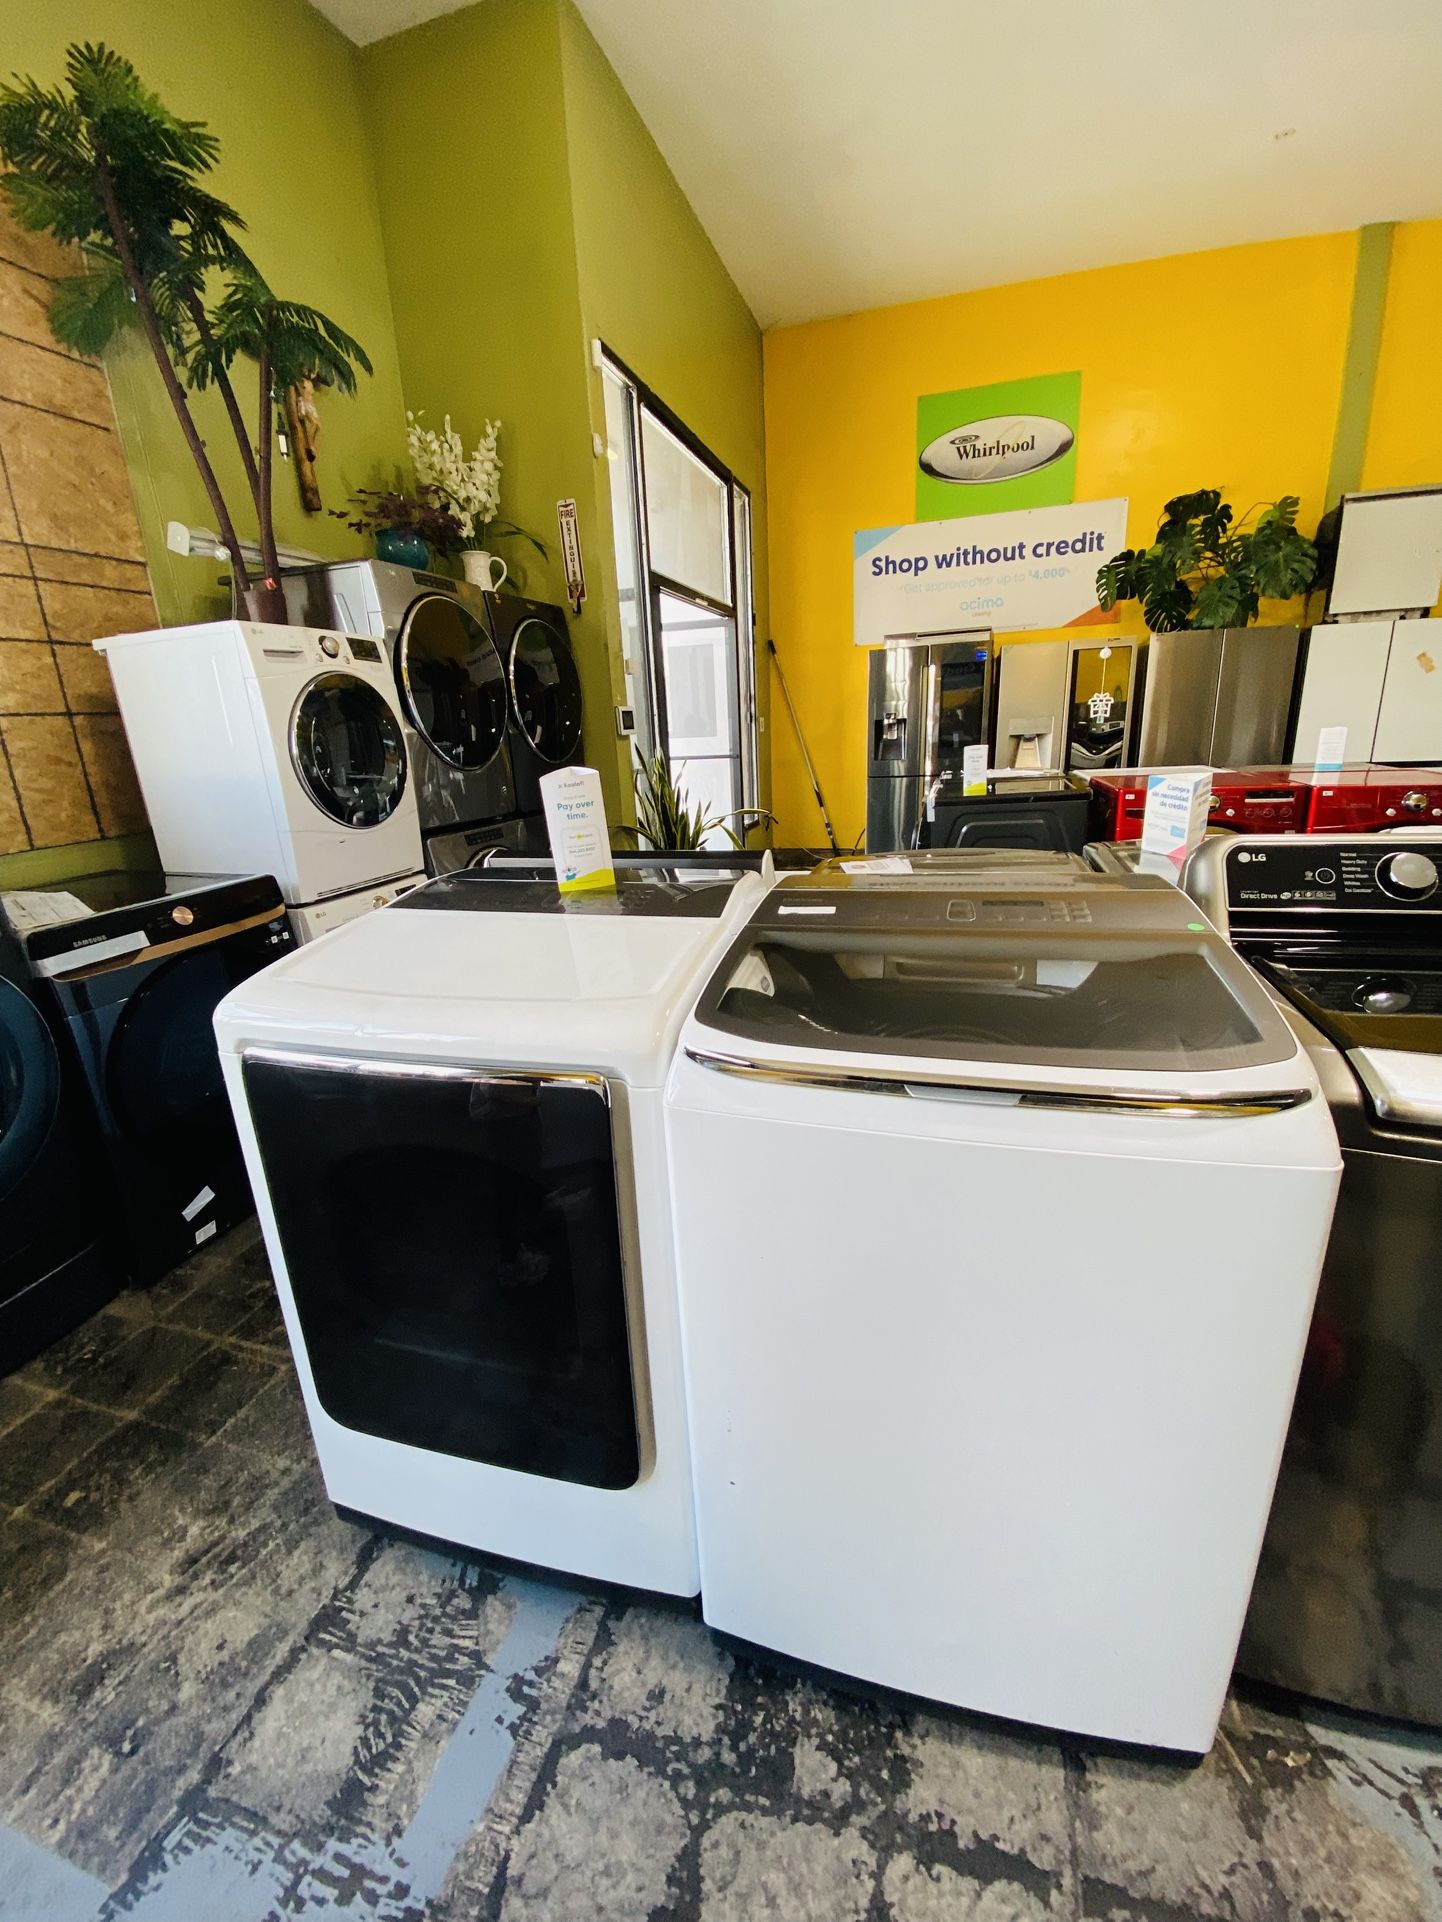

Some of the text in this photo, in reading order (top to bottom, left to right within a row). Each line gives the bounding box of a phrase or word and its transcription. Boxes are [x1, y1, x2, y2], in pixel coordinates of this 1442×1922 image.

[957, 436, 1036, 461] Whirlpool
[561, 509, 574, 519] FIRE
[872, 531, 1104, 577] Shop without credit
[959, 596, 1004, 611] acima
[557, 800, 595, 812] Pay over
[566, 812, 589, 820] time.
[1252, 853, 1267, 862] LG
